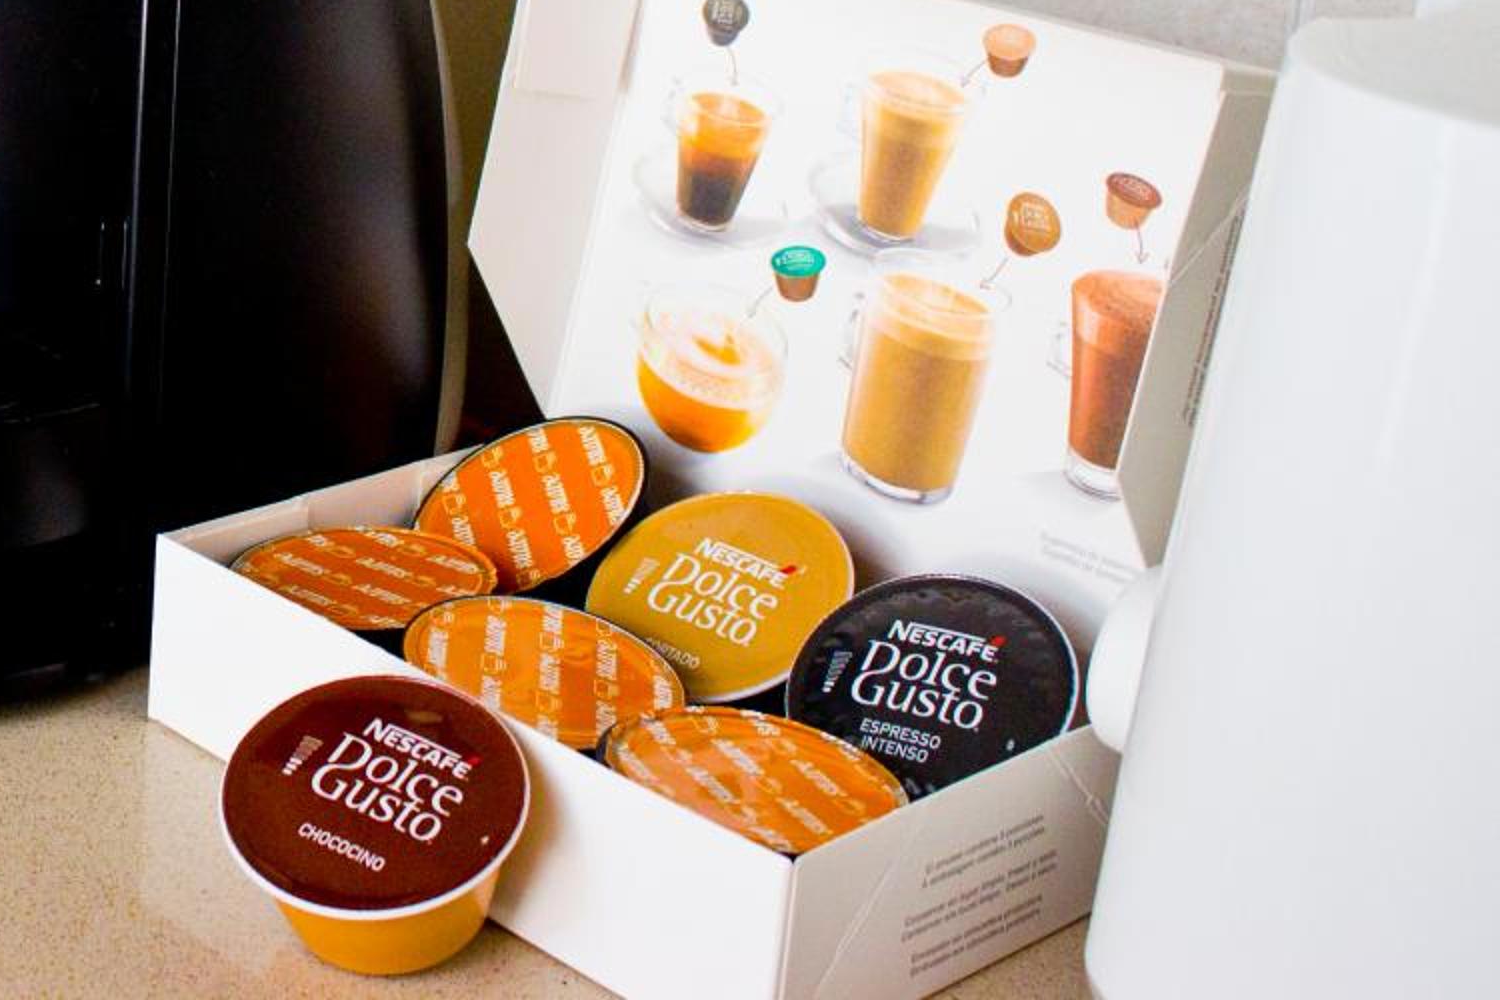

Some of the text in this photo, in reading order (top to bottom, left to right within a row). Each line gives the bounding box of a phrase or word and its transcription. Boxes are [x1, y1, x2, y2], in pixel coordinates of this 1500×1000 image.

[647, 580, 757, 646] Gusto
[663, 553, 779, 620] Dolce
[850, 670, 984, 730] Gusto
[859, 639, 998, 701] Dolce
[859, 717, 942, 751] ESPRESSO
[860, 734, 929, 764] INTENSO
[311, 762, 442, 842] Gusto
[327, 731, 464, 817] Dolce
[297, 822, 386, 872] CHOCOCINO
